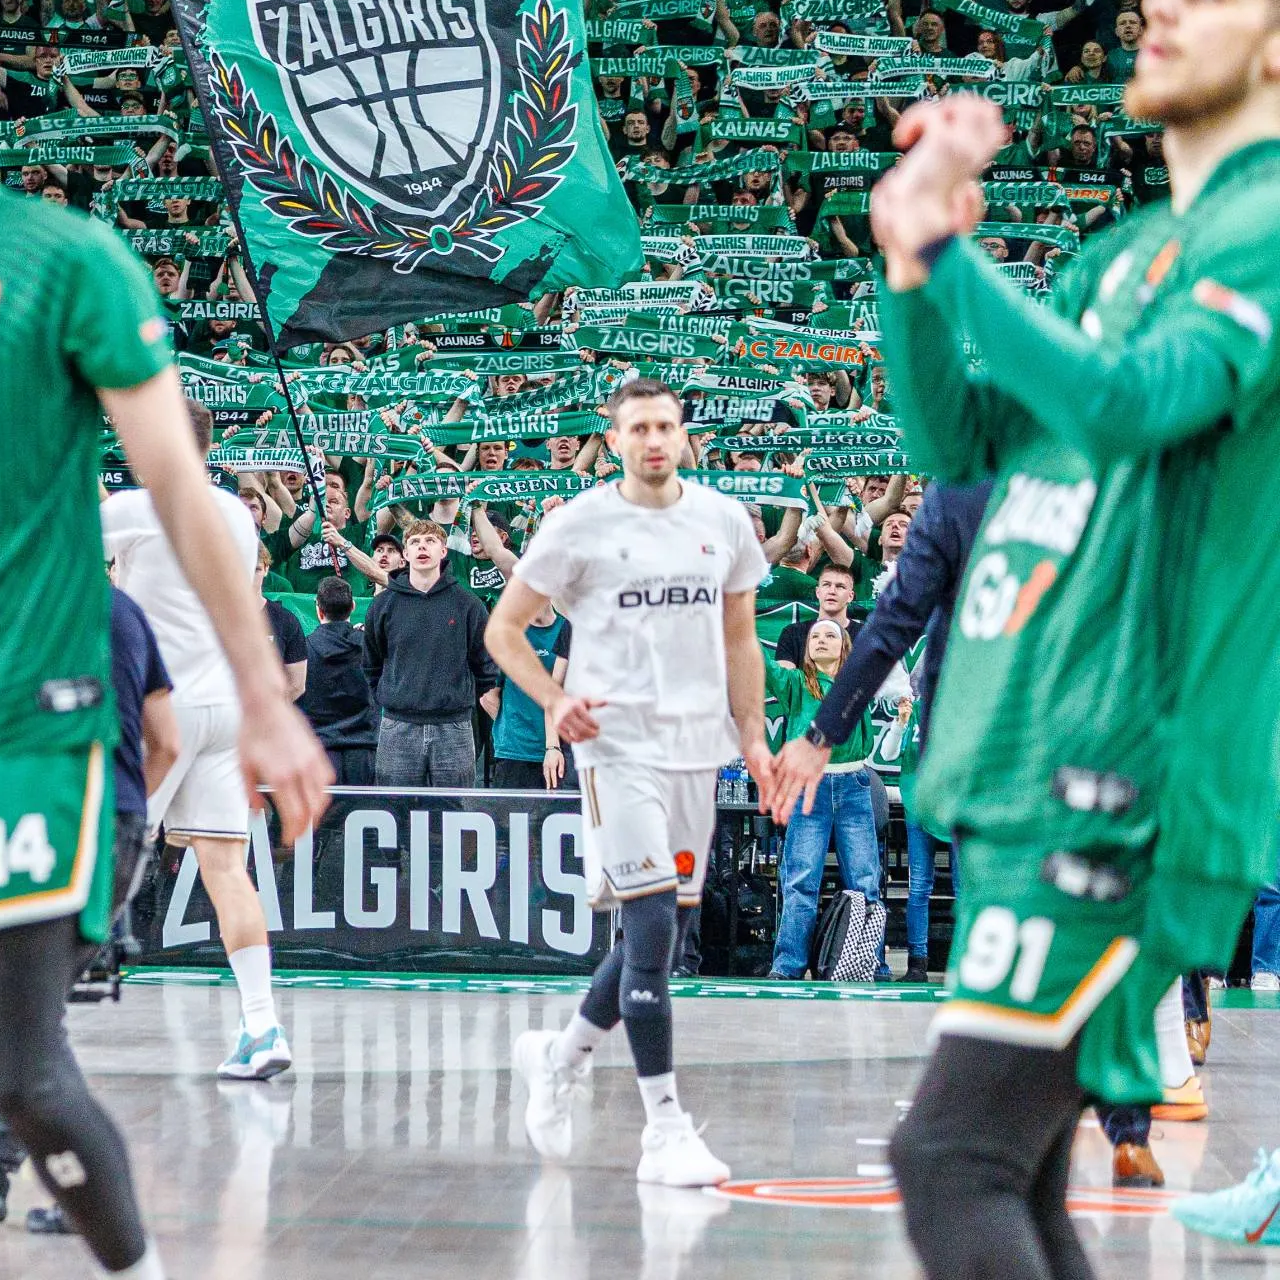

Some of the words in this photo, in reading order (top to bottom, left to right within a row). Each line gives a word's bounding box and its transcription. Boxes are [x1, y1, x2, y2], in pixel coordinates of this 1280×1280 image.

[81, 34, 108, 45] 1944
[711, 121, 791, 137] KAUNAS
[993, 170, 1033, 180] KAUNAS
[1079, 173, 1106, 183] 1944
[404, 176, 443, 196] 1944
[436, 335, 486, 347] KAUNAS
[215, 411, 249, 421] 1944
[723, 435, 801, 448] GREEN
[811, 433, 900, 447] LEGION
[807, 454, 878, 471] GREEN
[484, 479, 561, 496] GREEN
[618, 587, 717, 609] DUBAI
[961, 907, 1053, 1002] 91
